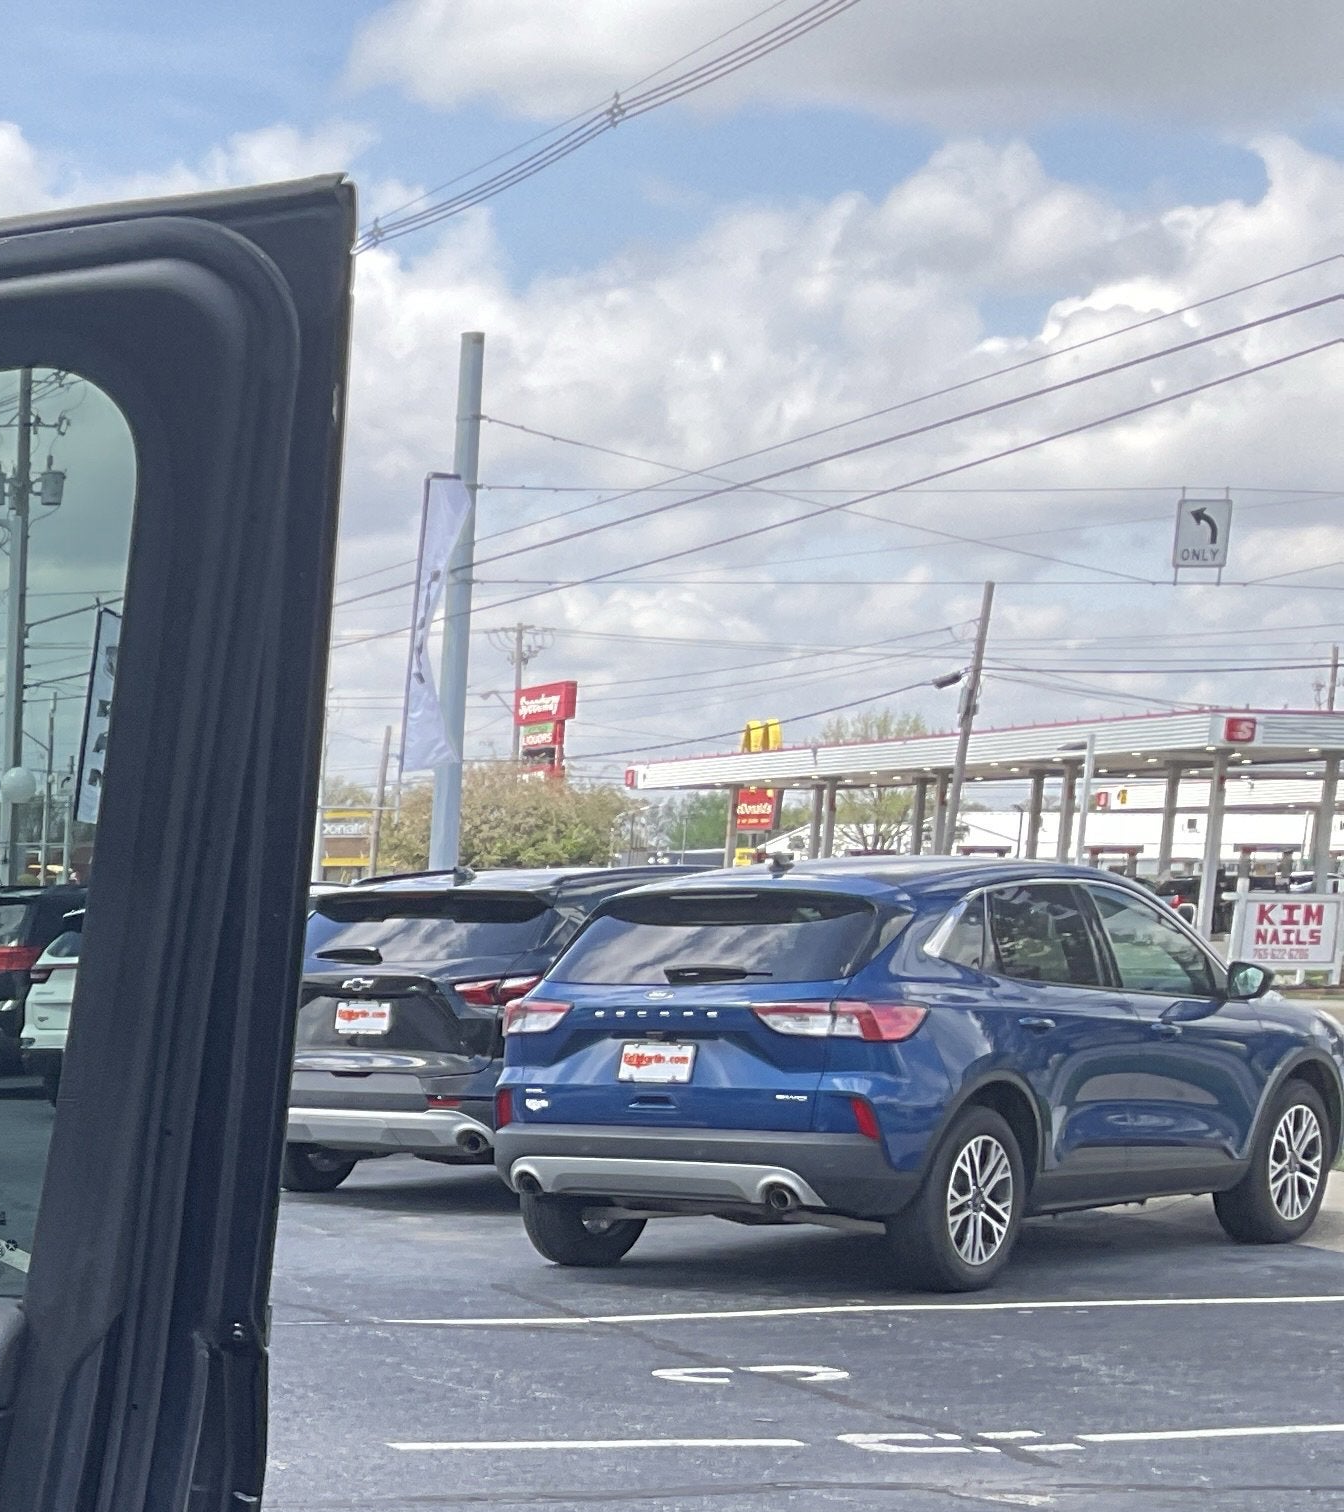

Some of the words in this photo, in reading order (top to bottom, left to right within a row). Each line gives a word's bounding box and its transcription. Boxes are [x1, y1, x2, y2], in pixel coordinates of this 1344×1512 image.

[1181, 549, 1219, 561] ONLY
[522, 733, 553, 746] LIQUORS
[1256, 903, 1325, 926] KIM
[1254, 928, 1322, 946] NAILS
